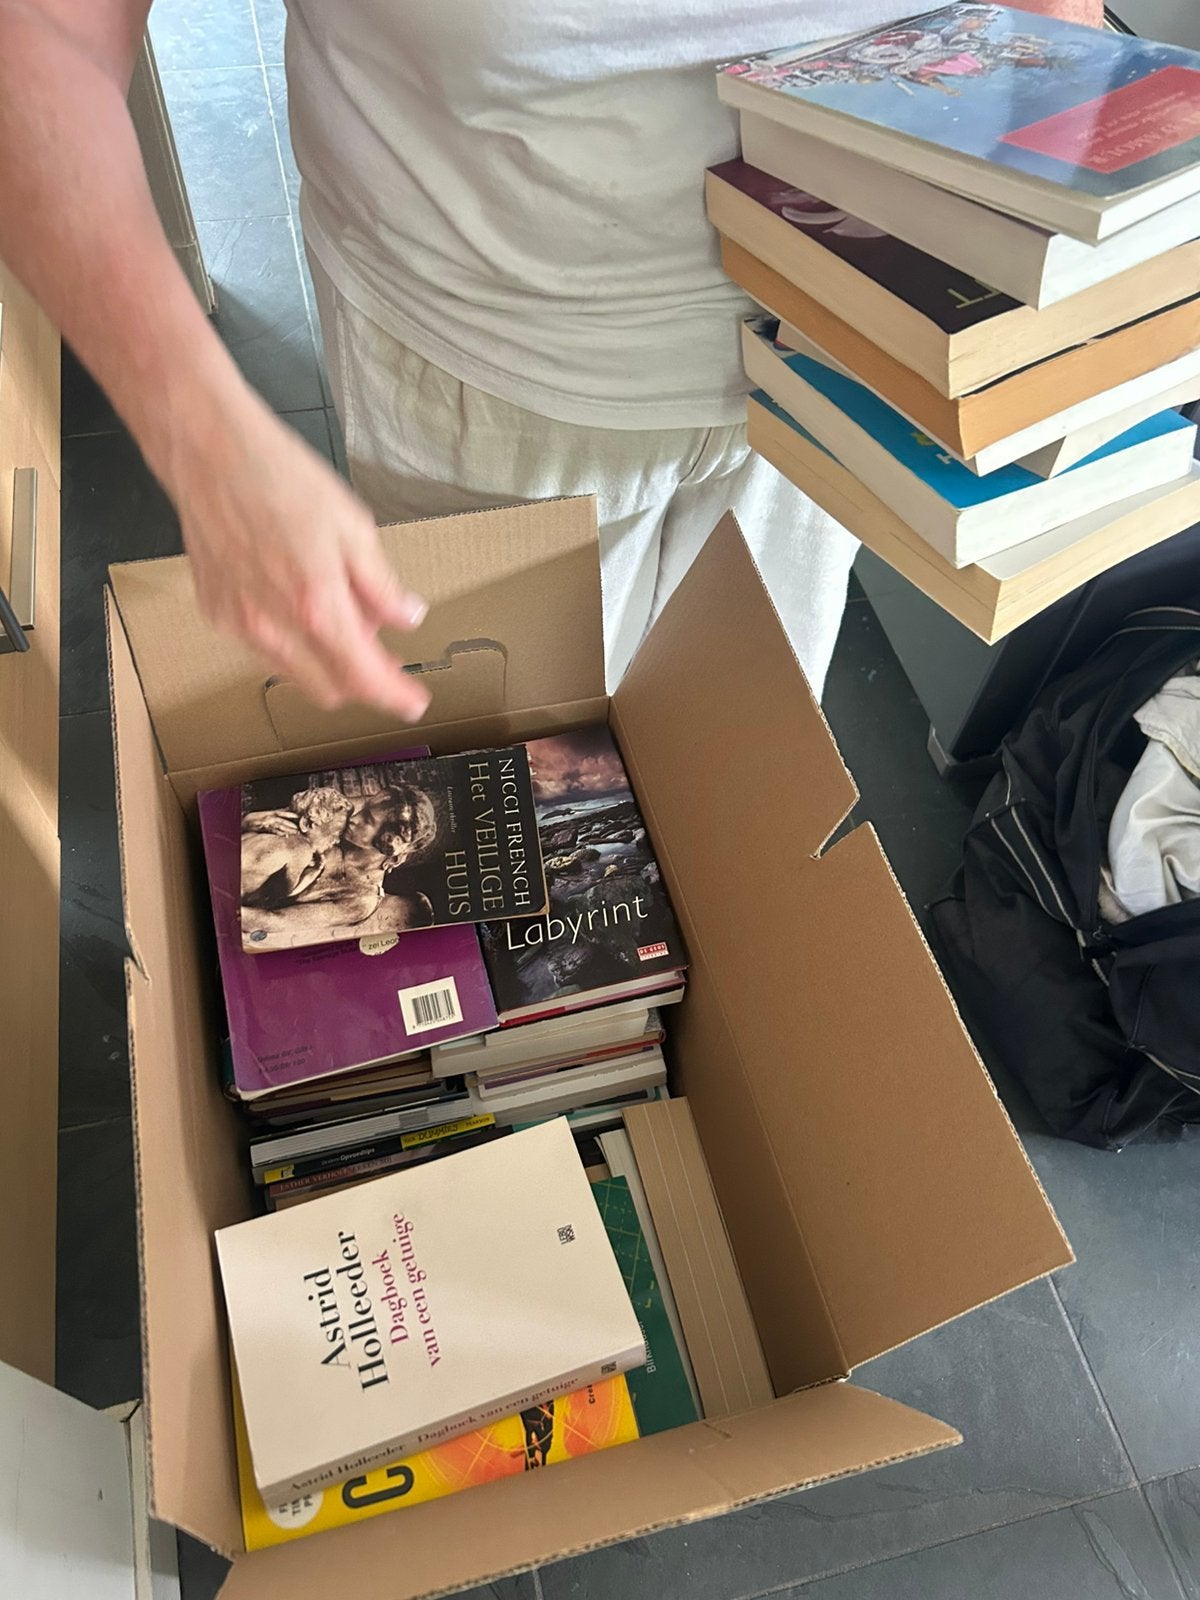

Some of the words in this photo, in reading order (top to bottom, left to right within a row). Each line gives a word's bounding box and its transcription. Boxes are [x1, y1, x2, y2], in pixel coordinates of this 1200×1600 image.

[469, 762, 490, 802] Het
[499, 758, 519, 815] NICCI
[445, 850, 470, 915] HUIS
[474, 808, 504, 911] VEILIGE
[507, 822, 530, 907] FRENCH
[507, 896, 648, 950] Labyrint
[465, 1117, 491, 1128] PEARSON
[393, 1213, 426, 1284] getuige
[303, 1266, 351, 1369] Astrid
[336, 1231, 390, 1393] Holleeder
[372, 1249, 408, 1344] Dagboek
[412, 1288, 431, 1325] een
[423, 1329, 441, 1367] van
[291, 1469, 334, 1491] Astrid
[337, 1444, 406, 1474] Holleeder
